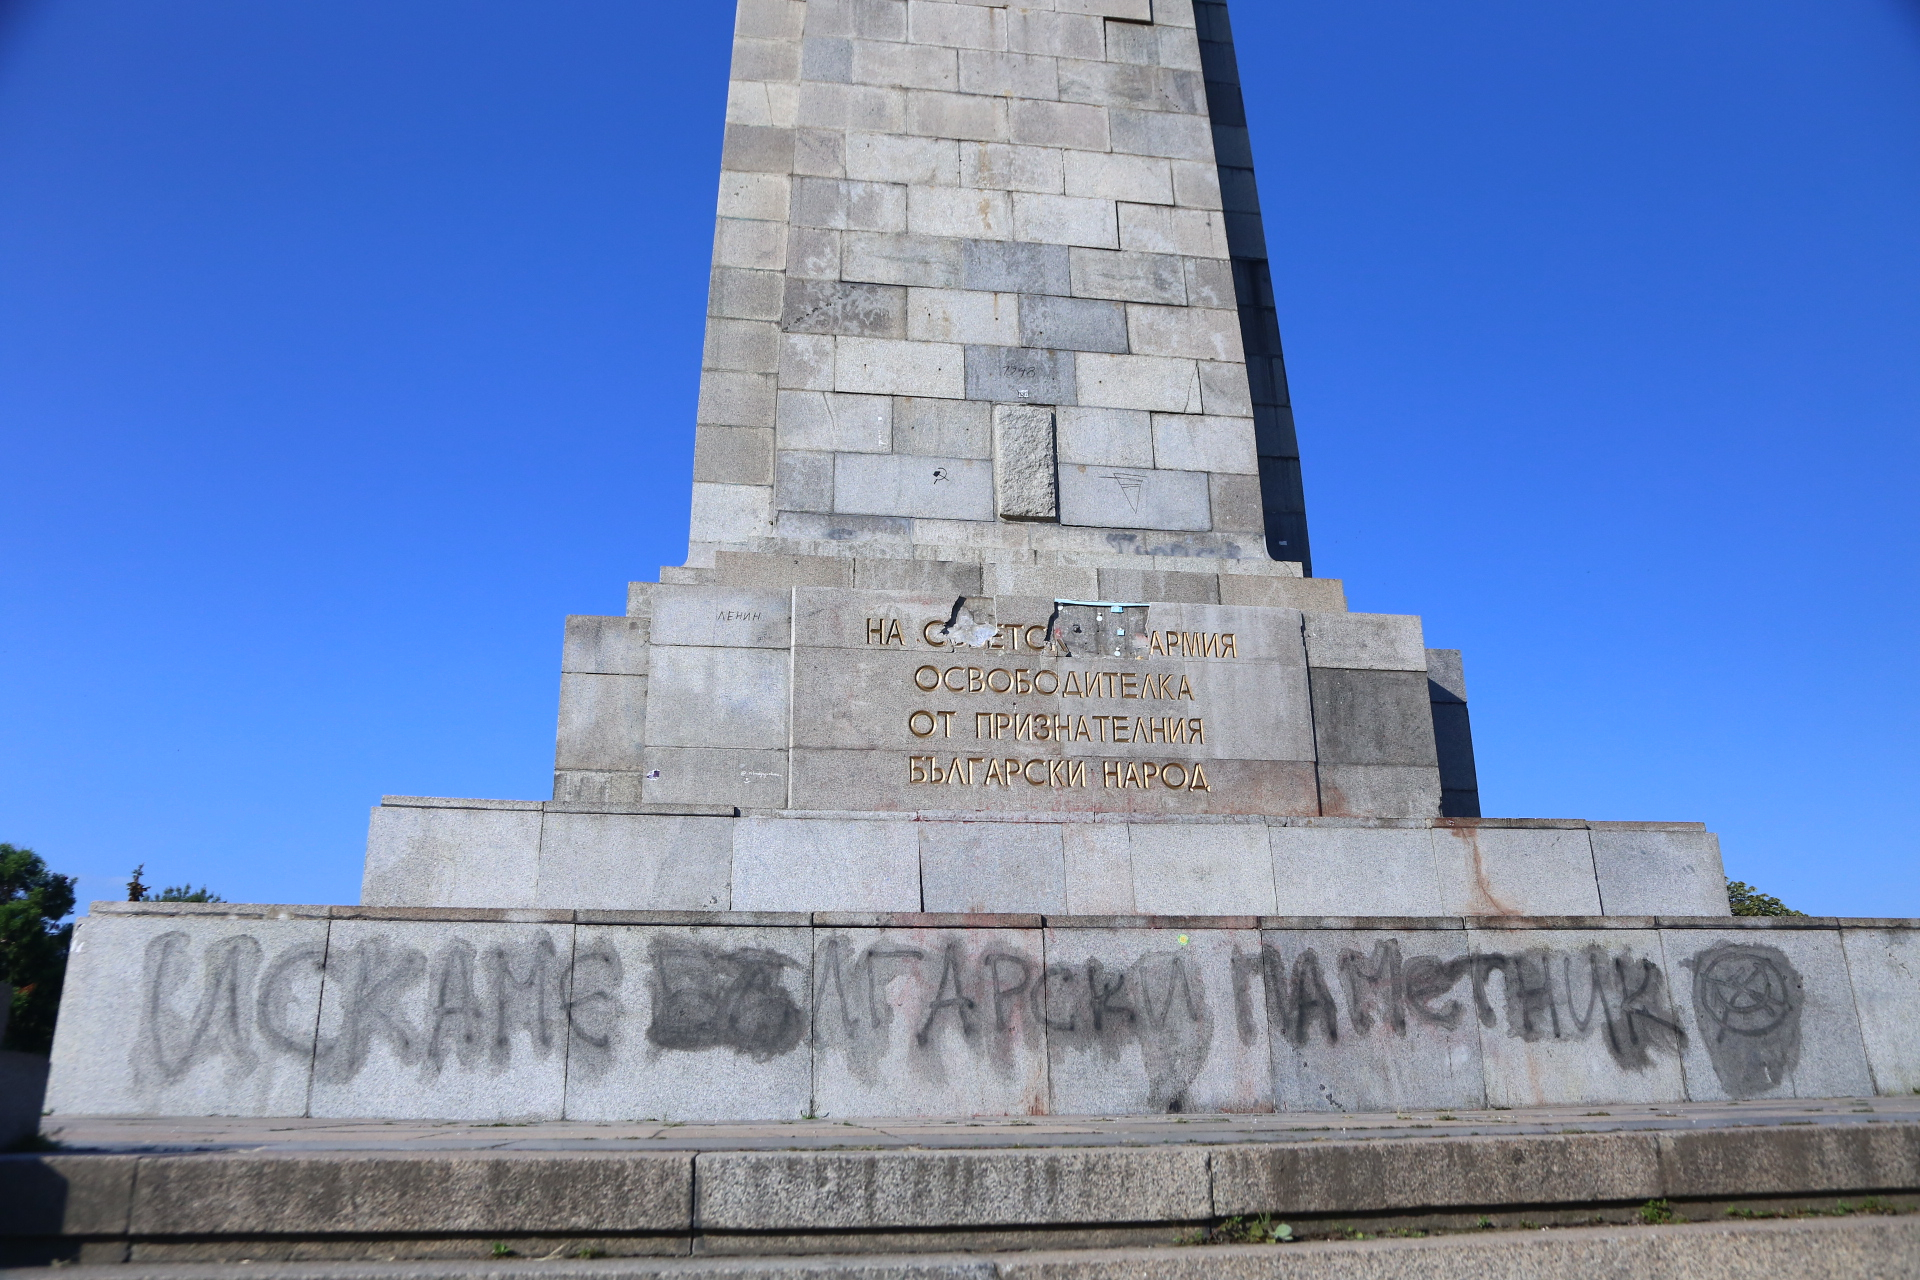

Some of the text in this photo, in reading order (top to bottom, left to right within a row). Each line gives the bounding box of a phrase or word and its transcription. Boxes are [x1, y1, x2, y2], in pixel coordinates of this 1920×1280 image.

[717, 610, 762, 621] ЛЕНИН
[866, 618, 906, 646] НА
[1149, 630, 1238, 659] АРМИЯ
[914, 665, 1195, 700] ОСВОБОДИТЕЛКА
[909, 710, 1205, 744] ОТ ПРИЗНАТЕЛНИЯ
[909, 756, 1211, 792] БЪЛГАРСКИ НАРОД
